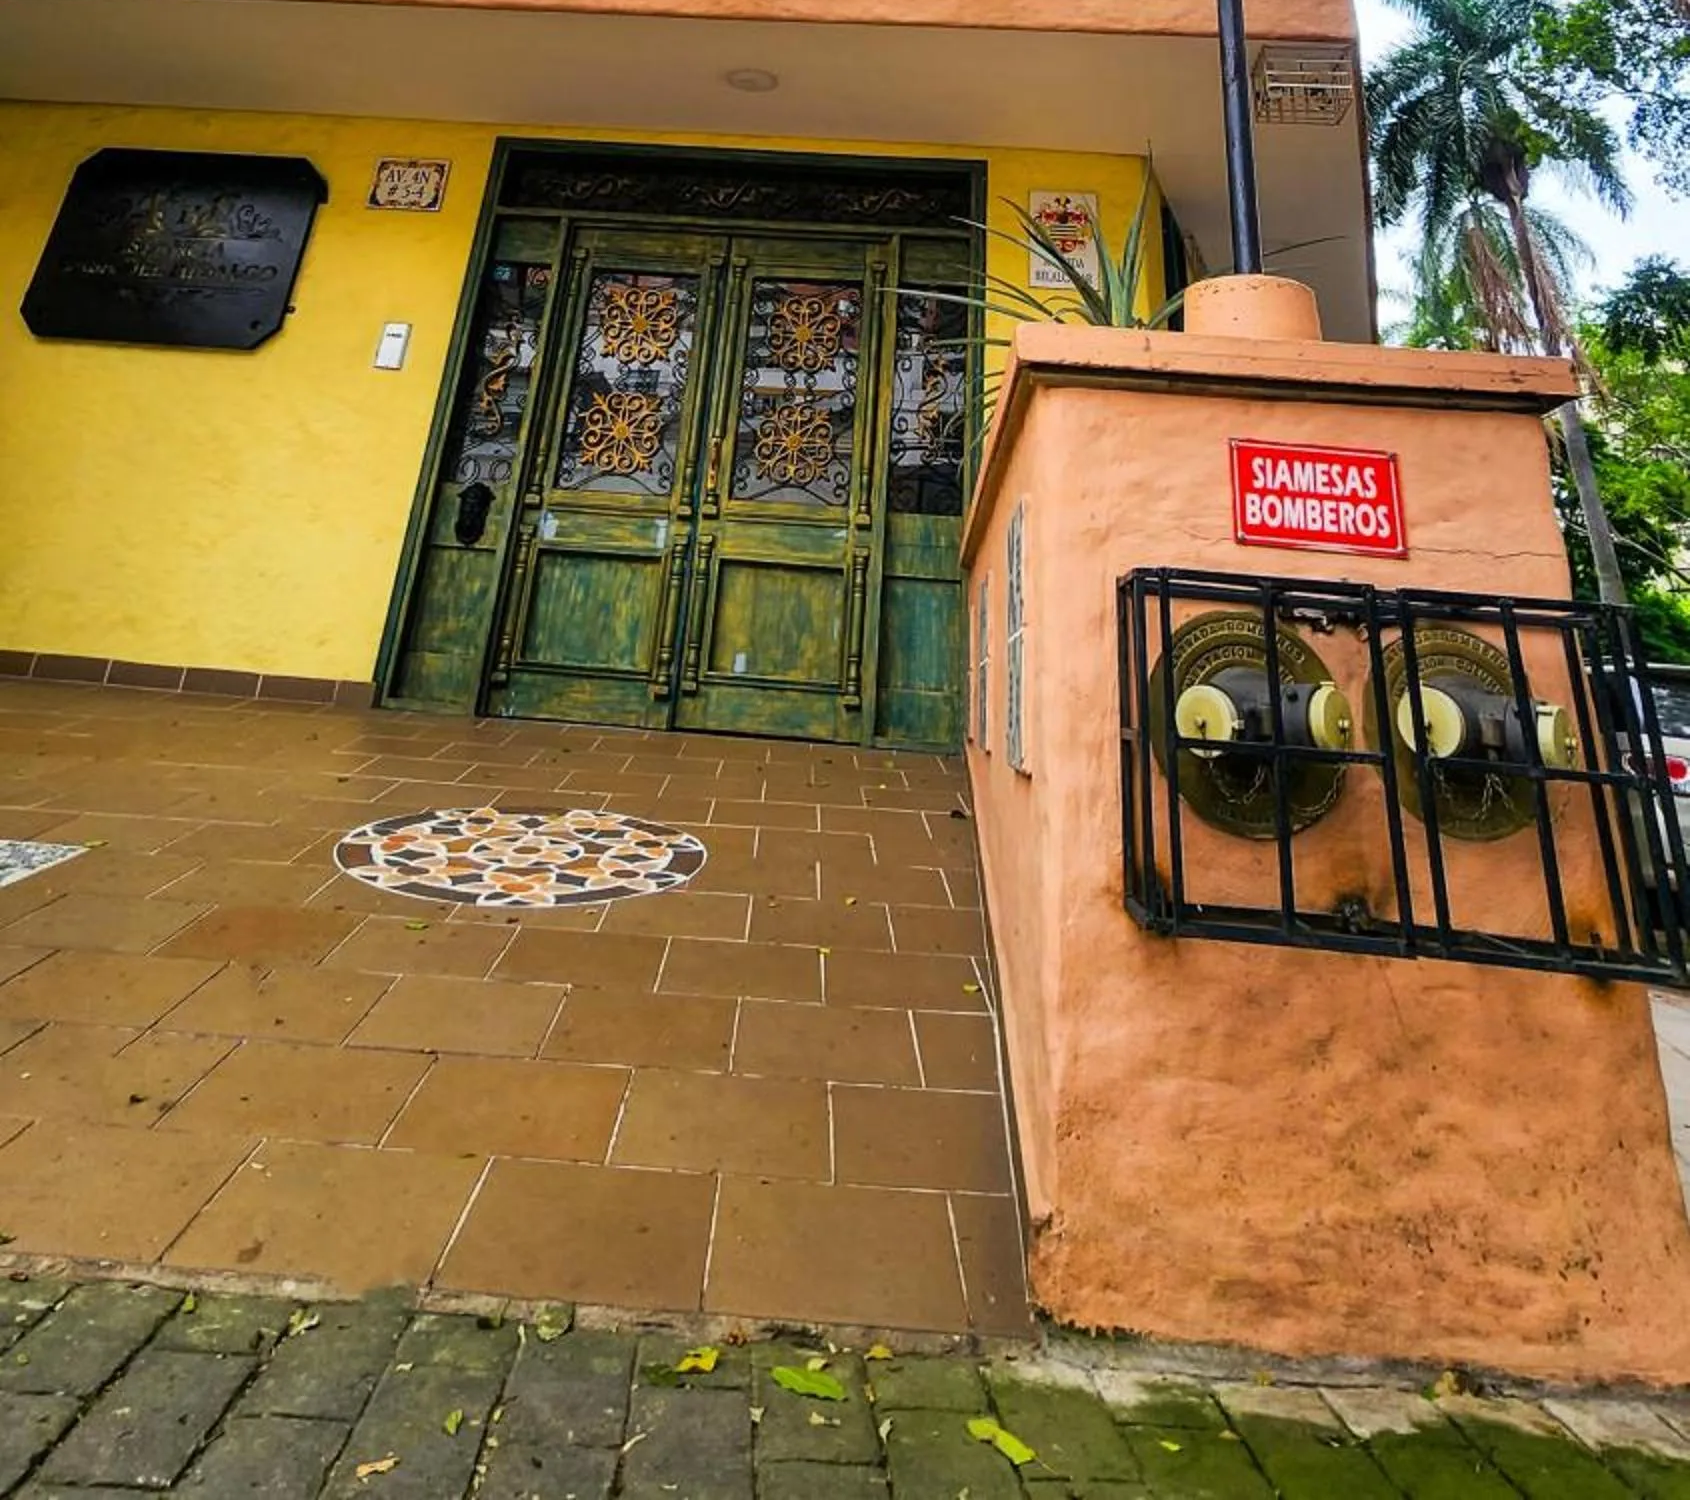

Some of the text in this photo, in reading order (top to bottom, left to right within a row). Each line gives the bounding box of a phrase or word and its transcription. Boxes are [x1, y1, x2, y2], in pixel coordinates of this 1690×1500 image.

[384, 169, 431, 184] AV. 4N
[1252, 457, 1377, 499] SIAMESAS
[1245, 493, 1391, 539] BOMBEROS
